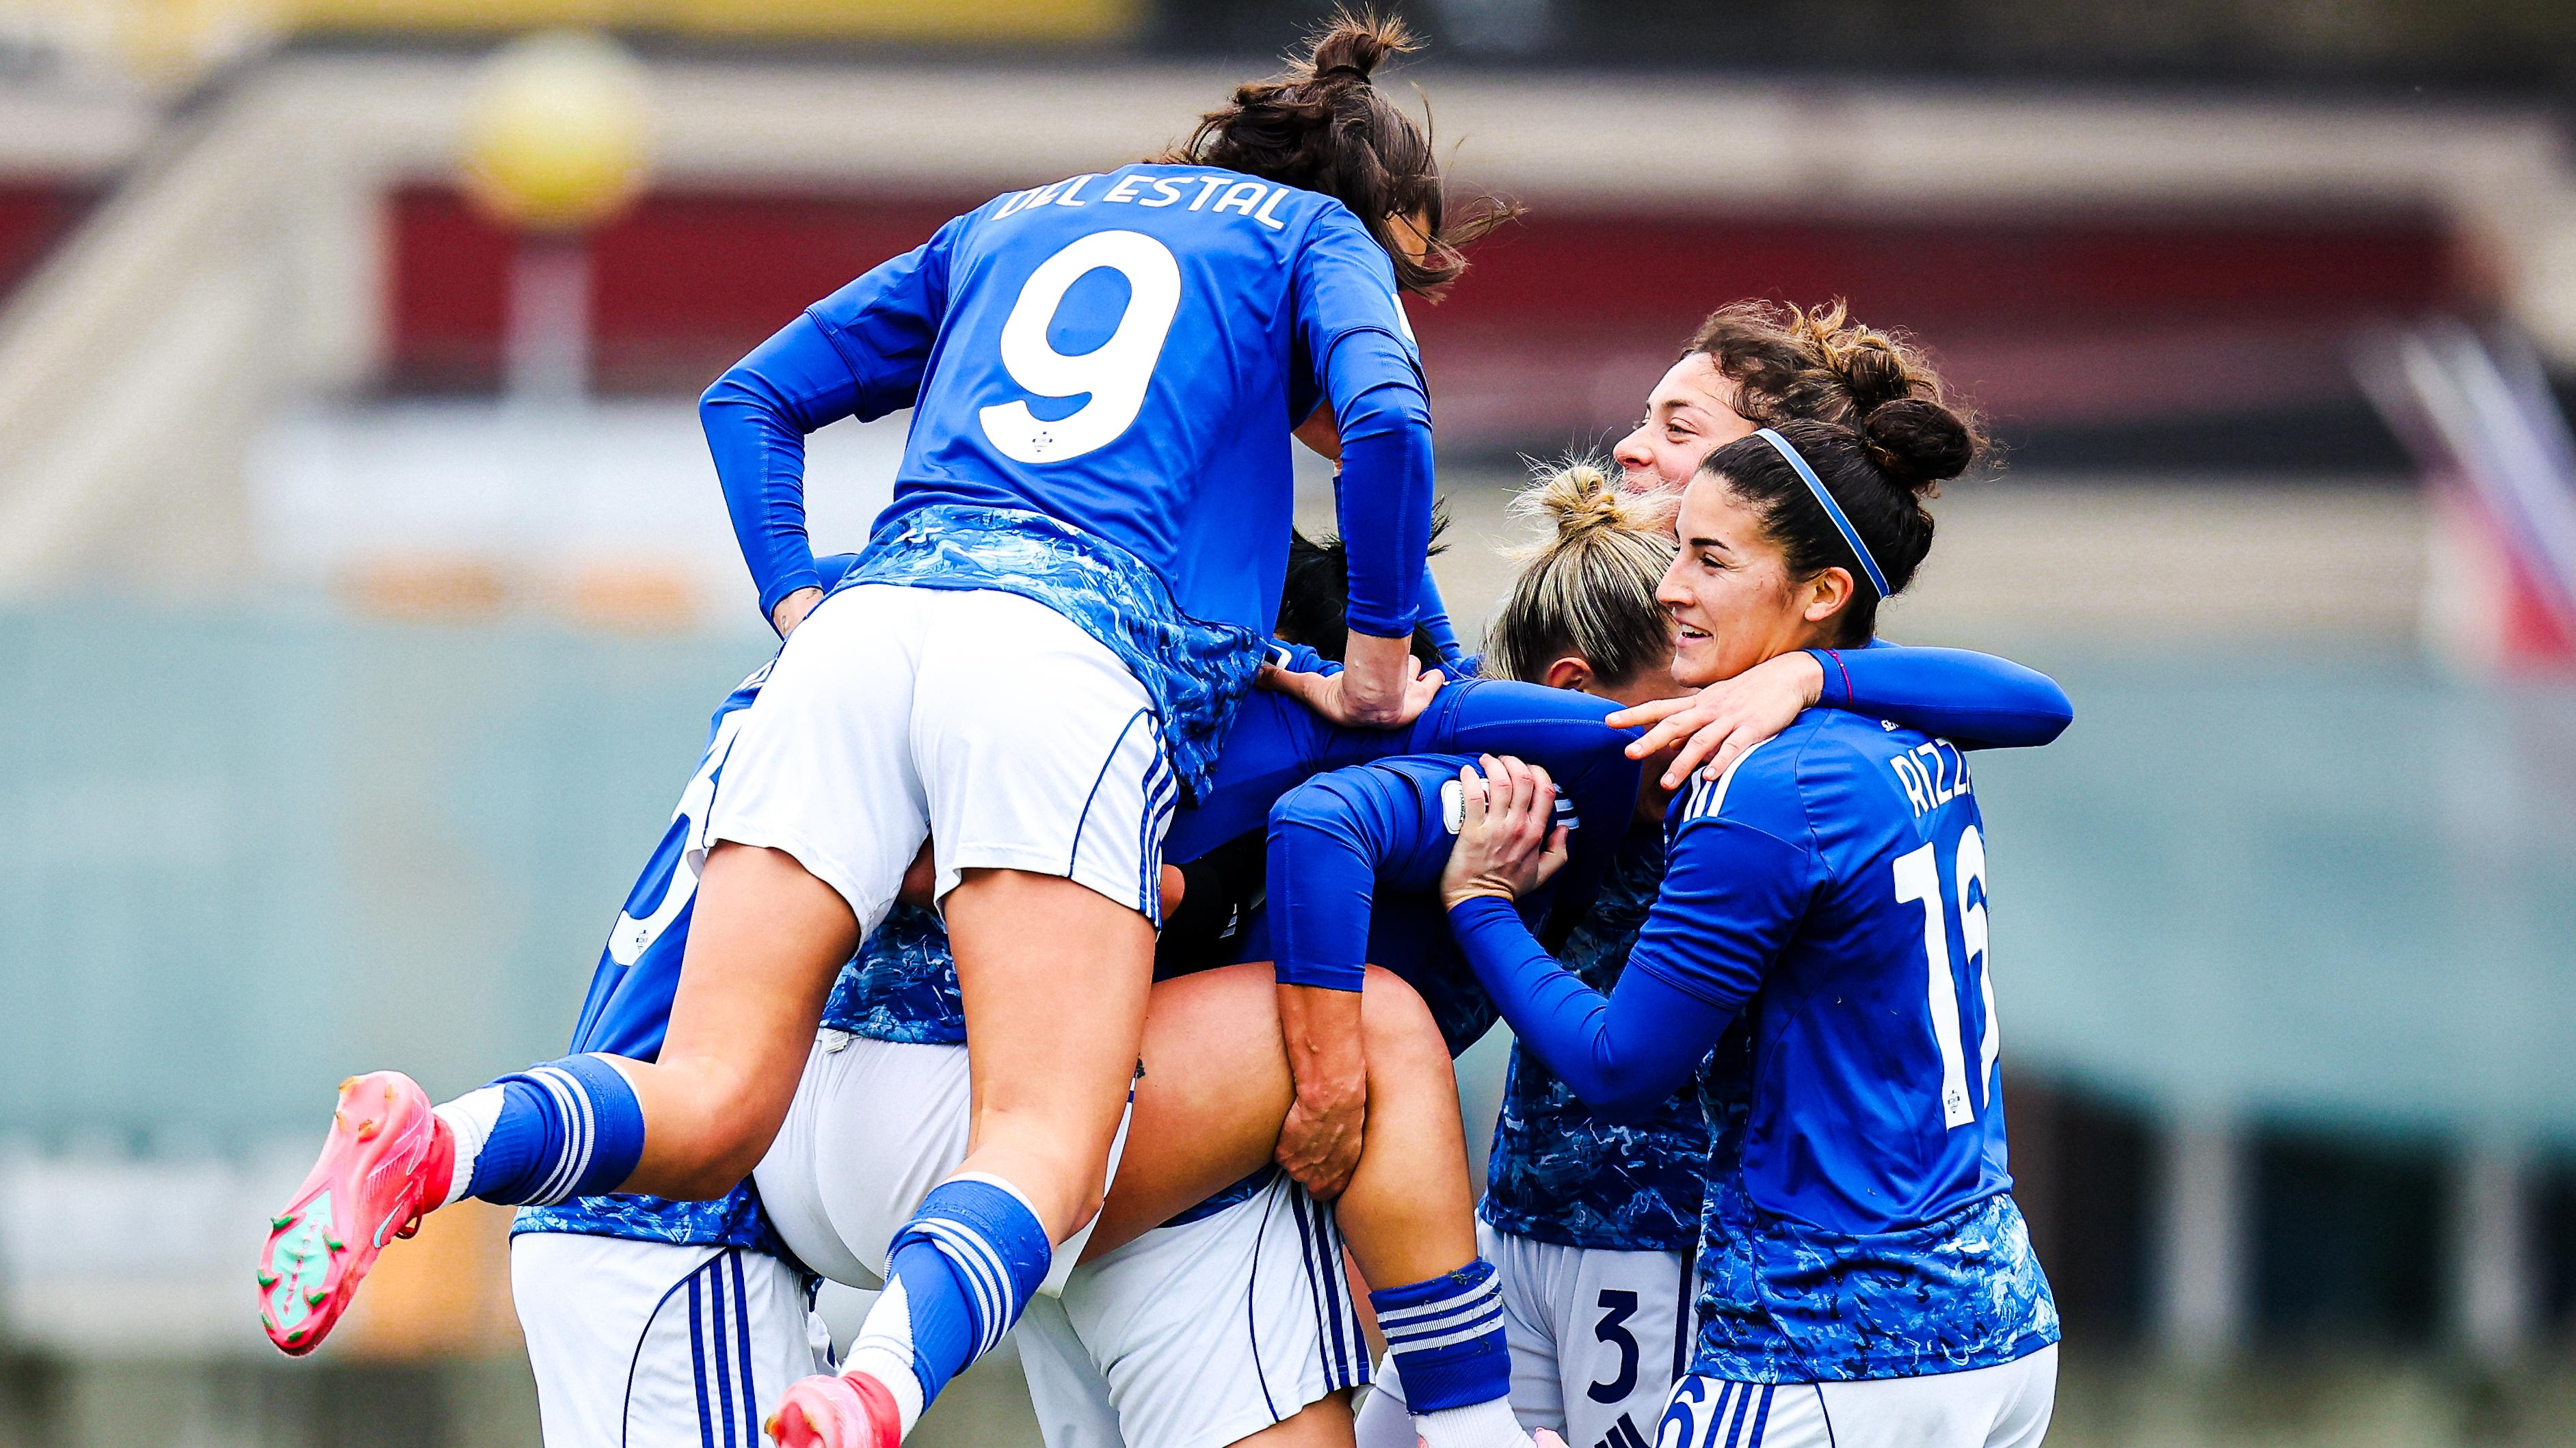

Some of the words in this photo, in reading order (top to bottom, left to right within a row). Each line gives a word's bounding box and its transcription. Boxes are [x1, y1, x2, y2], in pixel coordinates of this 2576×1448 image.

[990, 175, 1093, 221] DEL
[1102, 174, 1290, 230] ESTAL
[979, 229, 1182, 464] 9
[1889, 736, 1972, 819] RIZZ
[1586, 1289, 1640, 1404] 3
